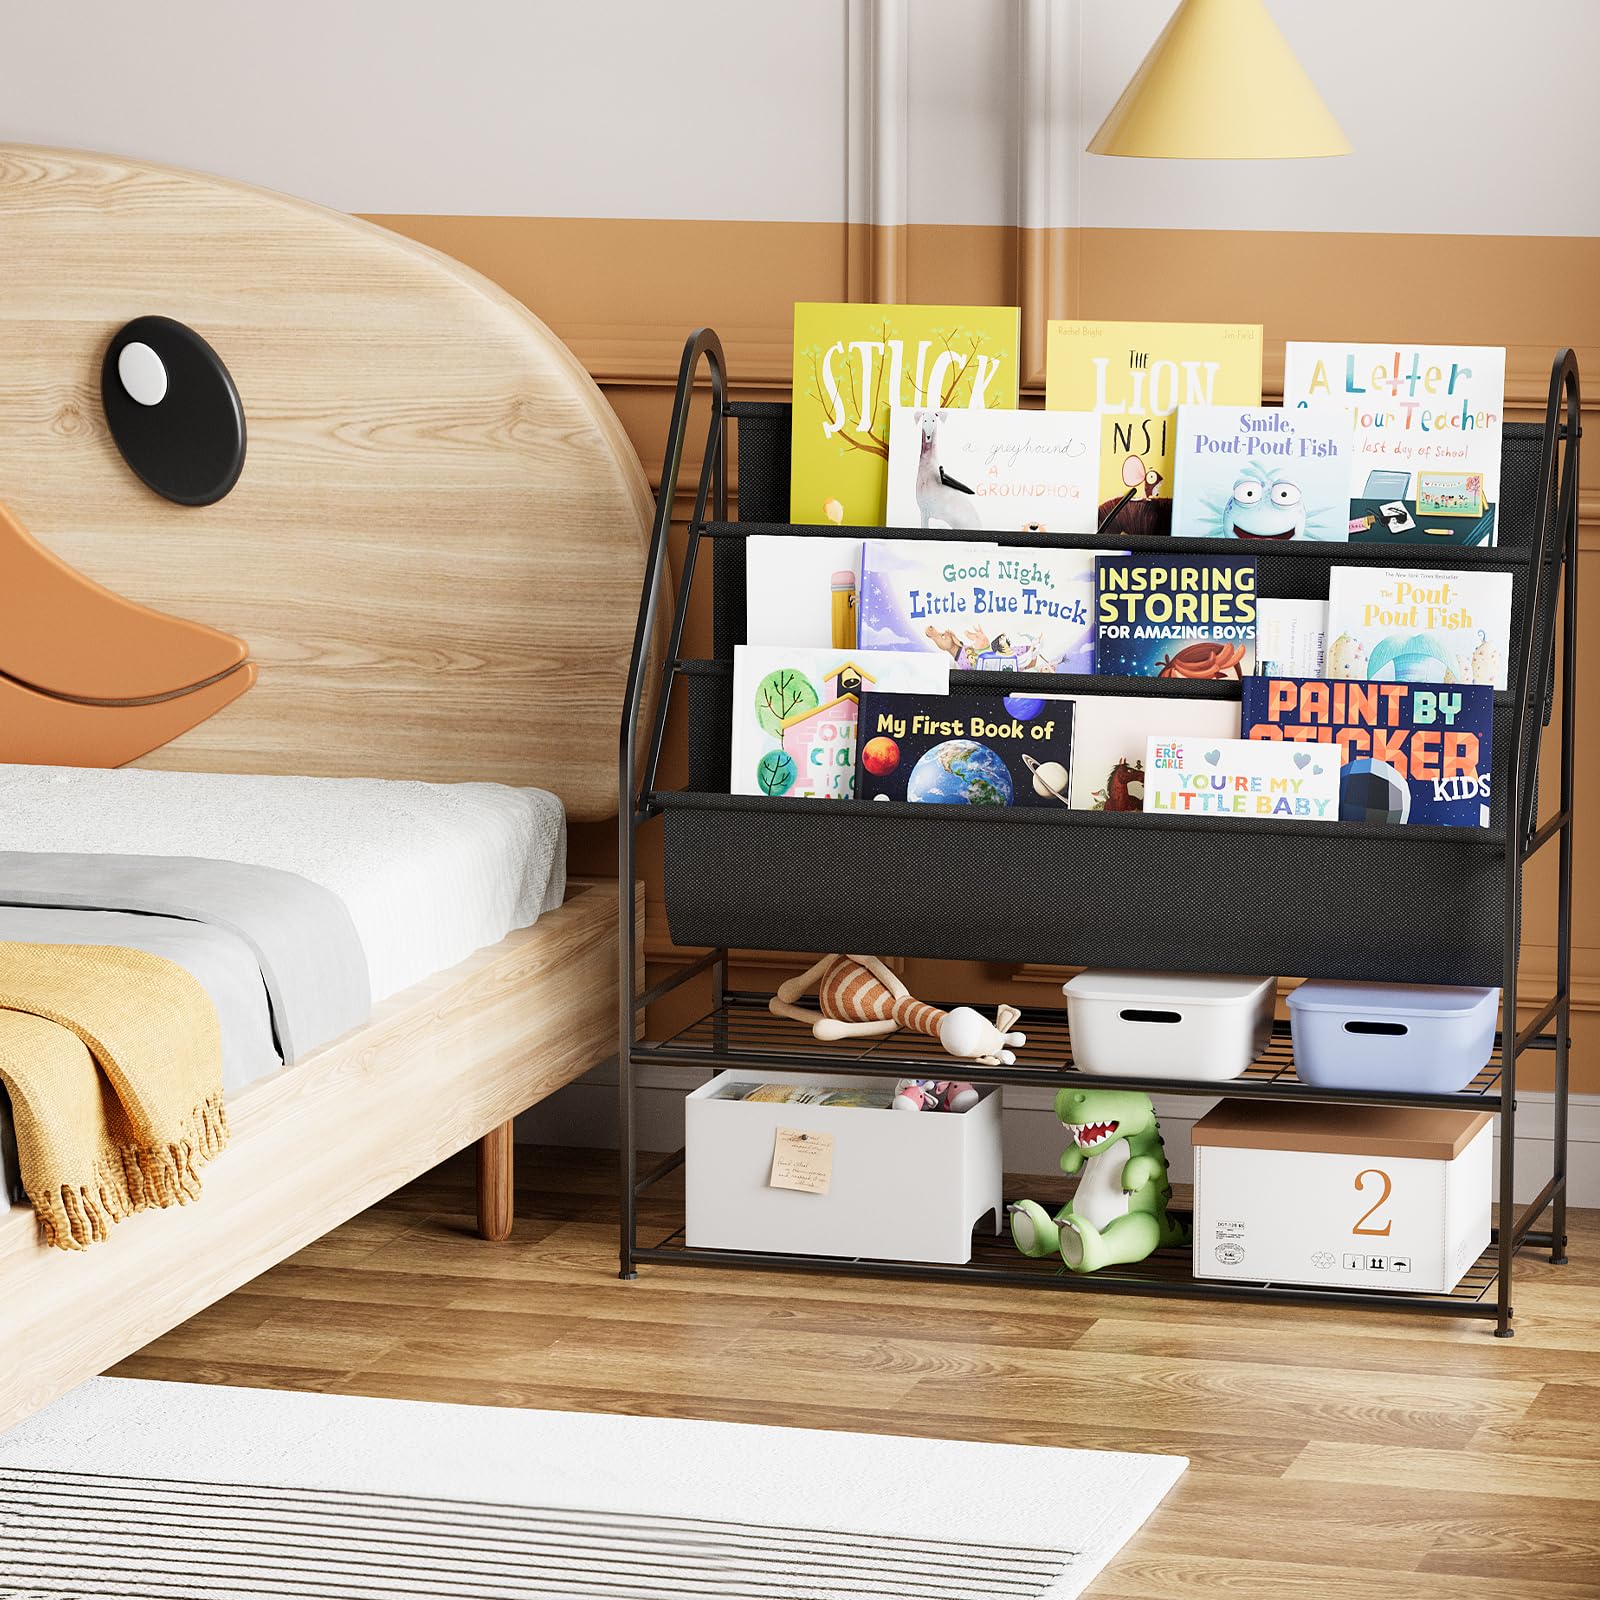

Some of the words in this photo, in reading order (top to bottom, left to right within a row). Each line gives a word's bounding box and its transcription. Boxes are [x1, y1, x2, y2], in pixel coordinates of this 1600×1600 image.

[1129, 349, 1149, 369] THE
[1308, 359, 1331, 394] A
[1345, 351, 1473, 397] Letter
[822, 339, 1000, 439] STUCK
[1240, 413, 1296, 435] Smile,
[1399, 399, 1497, 431] Teacher
[985, 435, 1087, 467] greyhound
[1193, 434, 1293, 456] Pout-Pout
[1298, 437, 1338, 458] Fish
[1394, 440, 1413, 459] day
[1418, 446, 1431, 459] of
[988, 465, 999, 478] A
[976, 482, 1080, 499] GROUNDHOG
[943, 560, 991, 583] Good
[998, 560, 1055, 590] Night,
[1100, 567, 1255, 592] INSPIRING
[1394, 581, 1458, 605] Pout-
[909, 590, 967, 619] Little
[973, 587, 1018, 614] Blue
[1022, 588, 1087, 626] Truck
[1099, 593, 1256, 623] STORIES
[1363, 604, 1419, 628] Pout
[1425, 607, 1473, 631] Fish
[1099, 625, 1130, 640] FOR
[1134, 625, 1209, 640] AMAZING
[1212, 625, 1256, 640] BOYS
[1268, 679, 1409, 727] PAINT
[1412, 690, 1462, 726] BY
[876, 713, 906, 739] My
[911, 715, 965, 737] First
[970, 717, 1025, 740] Book
[1030, 720, 1055, 740] of
[1155, 758, 1184, 770] CARLE
[1178, 773, 1263, 792] YOU'RE
[1270, 778, 1304, 794] MY
[1430, 773, 1491, 802] KIDS
[1154, 791, 1247, 813] LITTLE
[1256, 796, 1331, 817] BABY
[1352, 1169, 1392, 1236] 2
